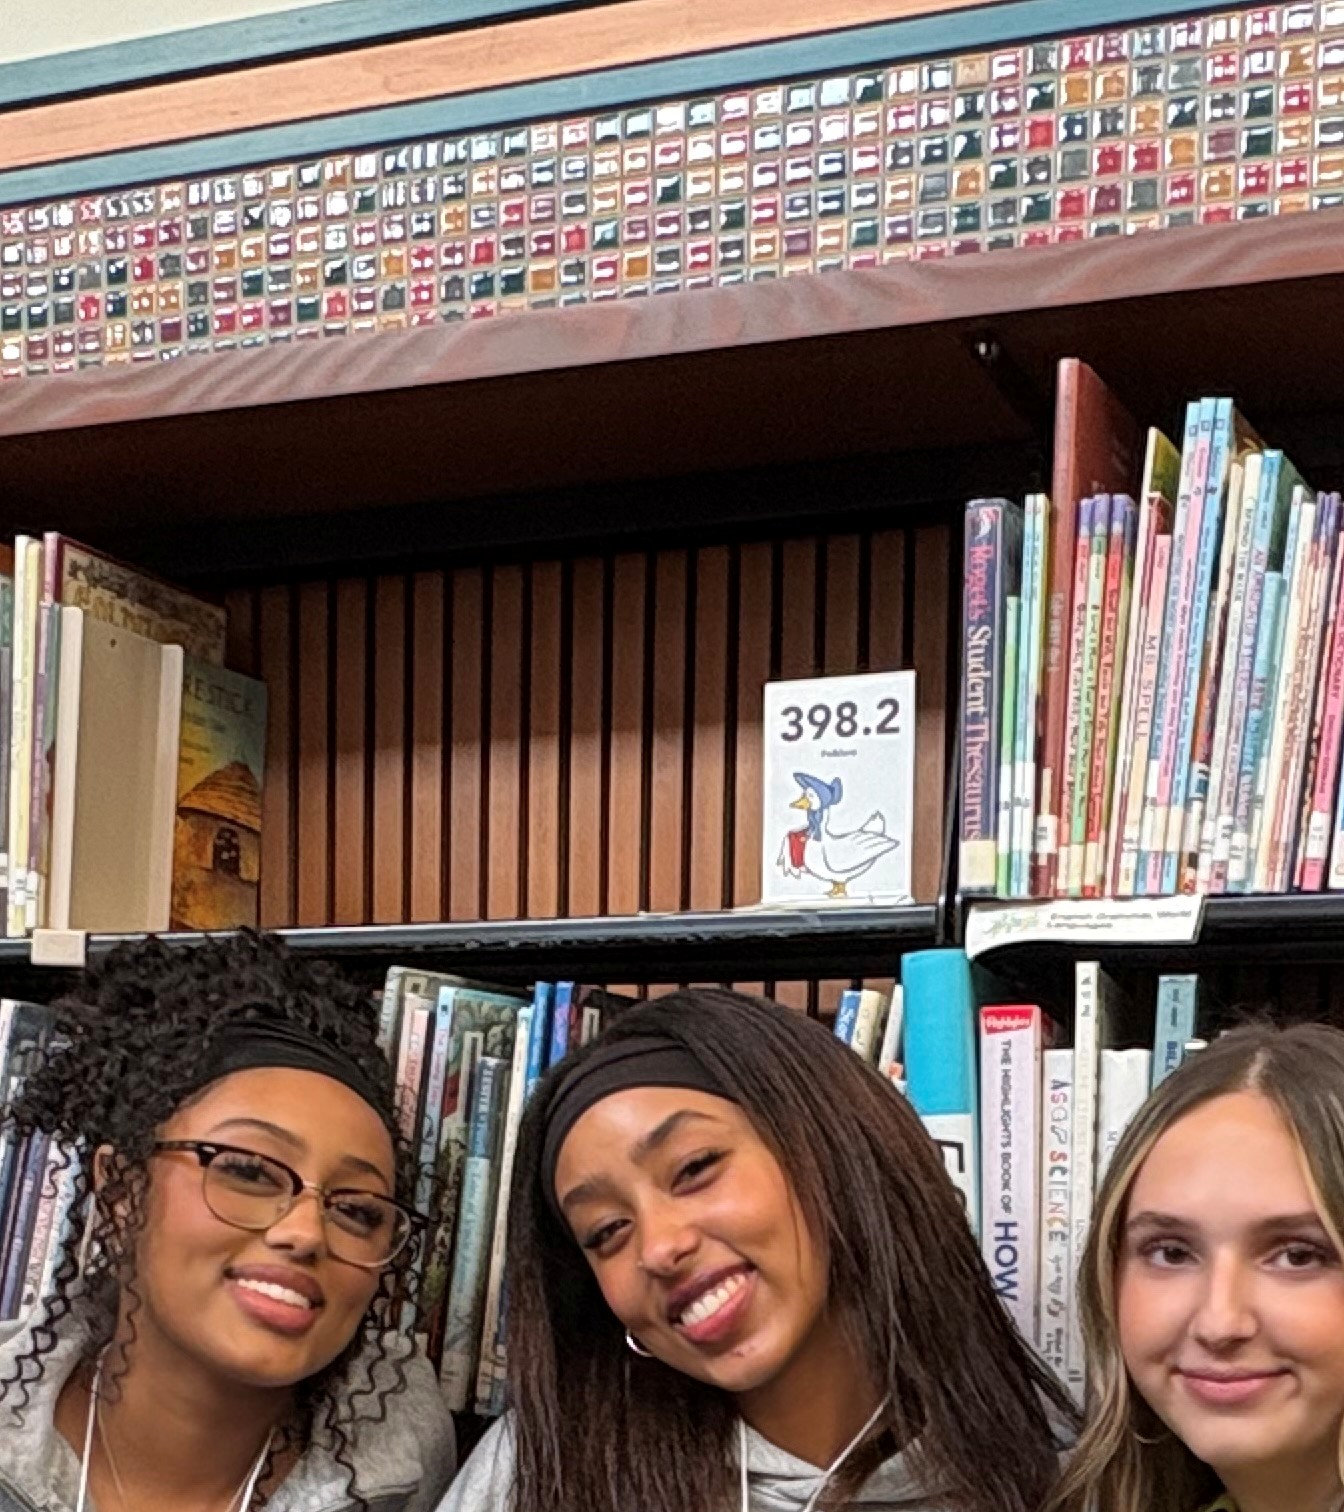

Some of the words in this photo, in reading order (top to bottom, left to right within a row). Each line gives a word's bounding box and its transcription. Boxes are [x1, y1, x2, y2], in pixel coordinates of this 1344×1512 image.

[967, 543, 995, 620] Roget's
[964, 624, 993, 715] Student
[780, 697, 900, 743] 398.2
[960, 715, 990, 839] Thesaurus
[999, 1038, 1011, 1064] THE
[999, 1068, 1011, 1148] HIGHLIGHTS
[999, 1151, 1011, 1190] BOOK
[999, 1194, 1011, 1214] OF
[1049, 1150, 1067, 1242] SCIENCE
[994, 1221, 1018, 1301] HOW
